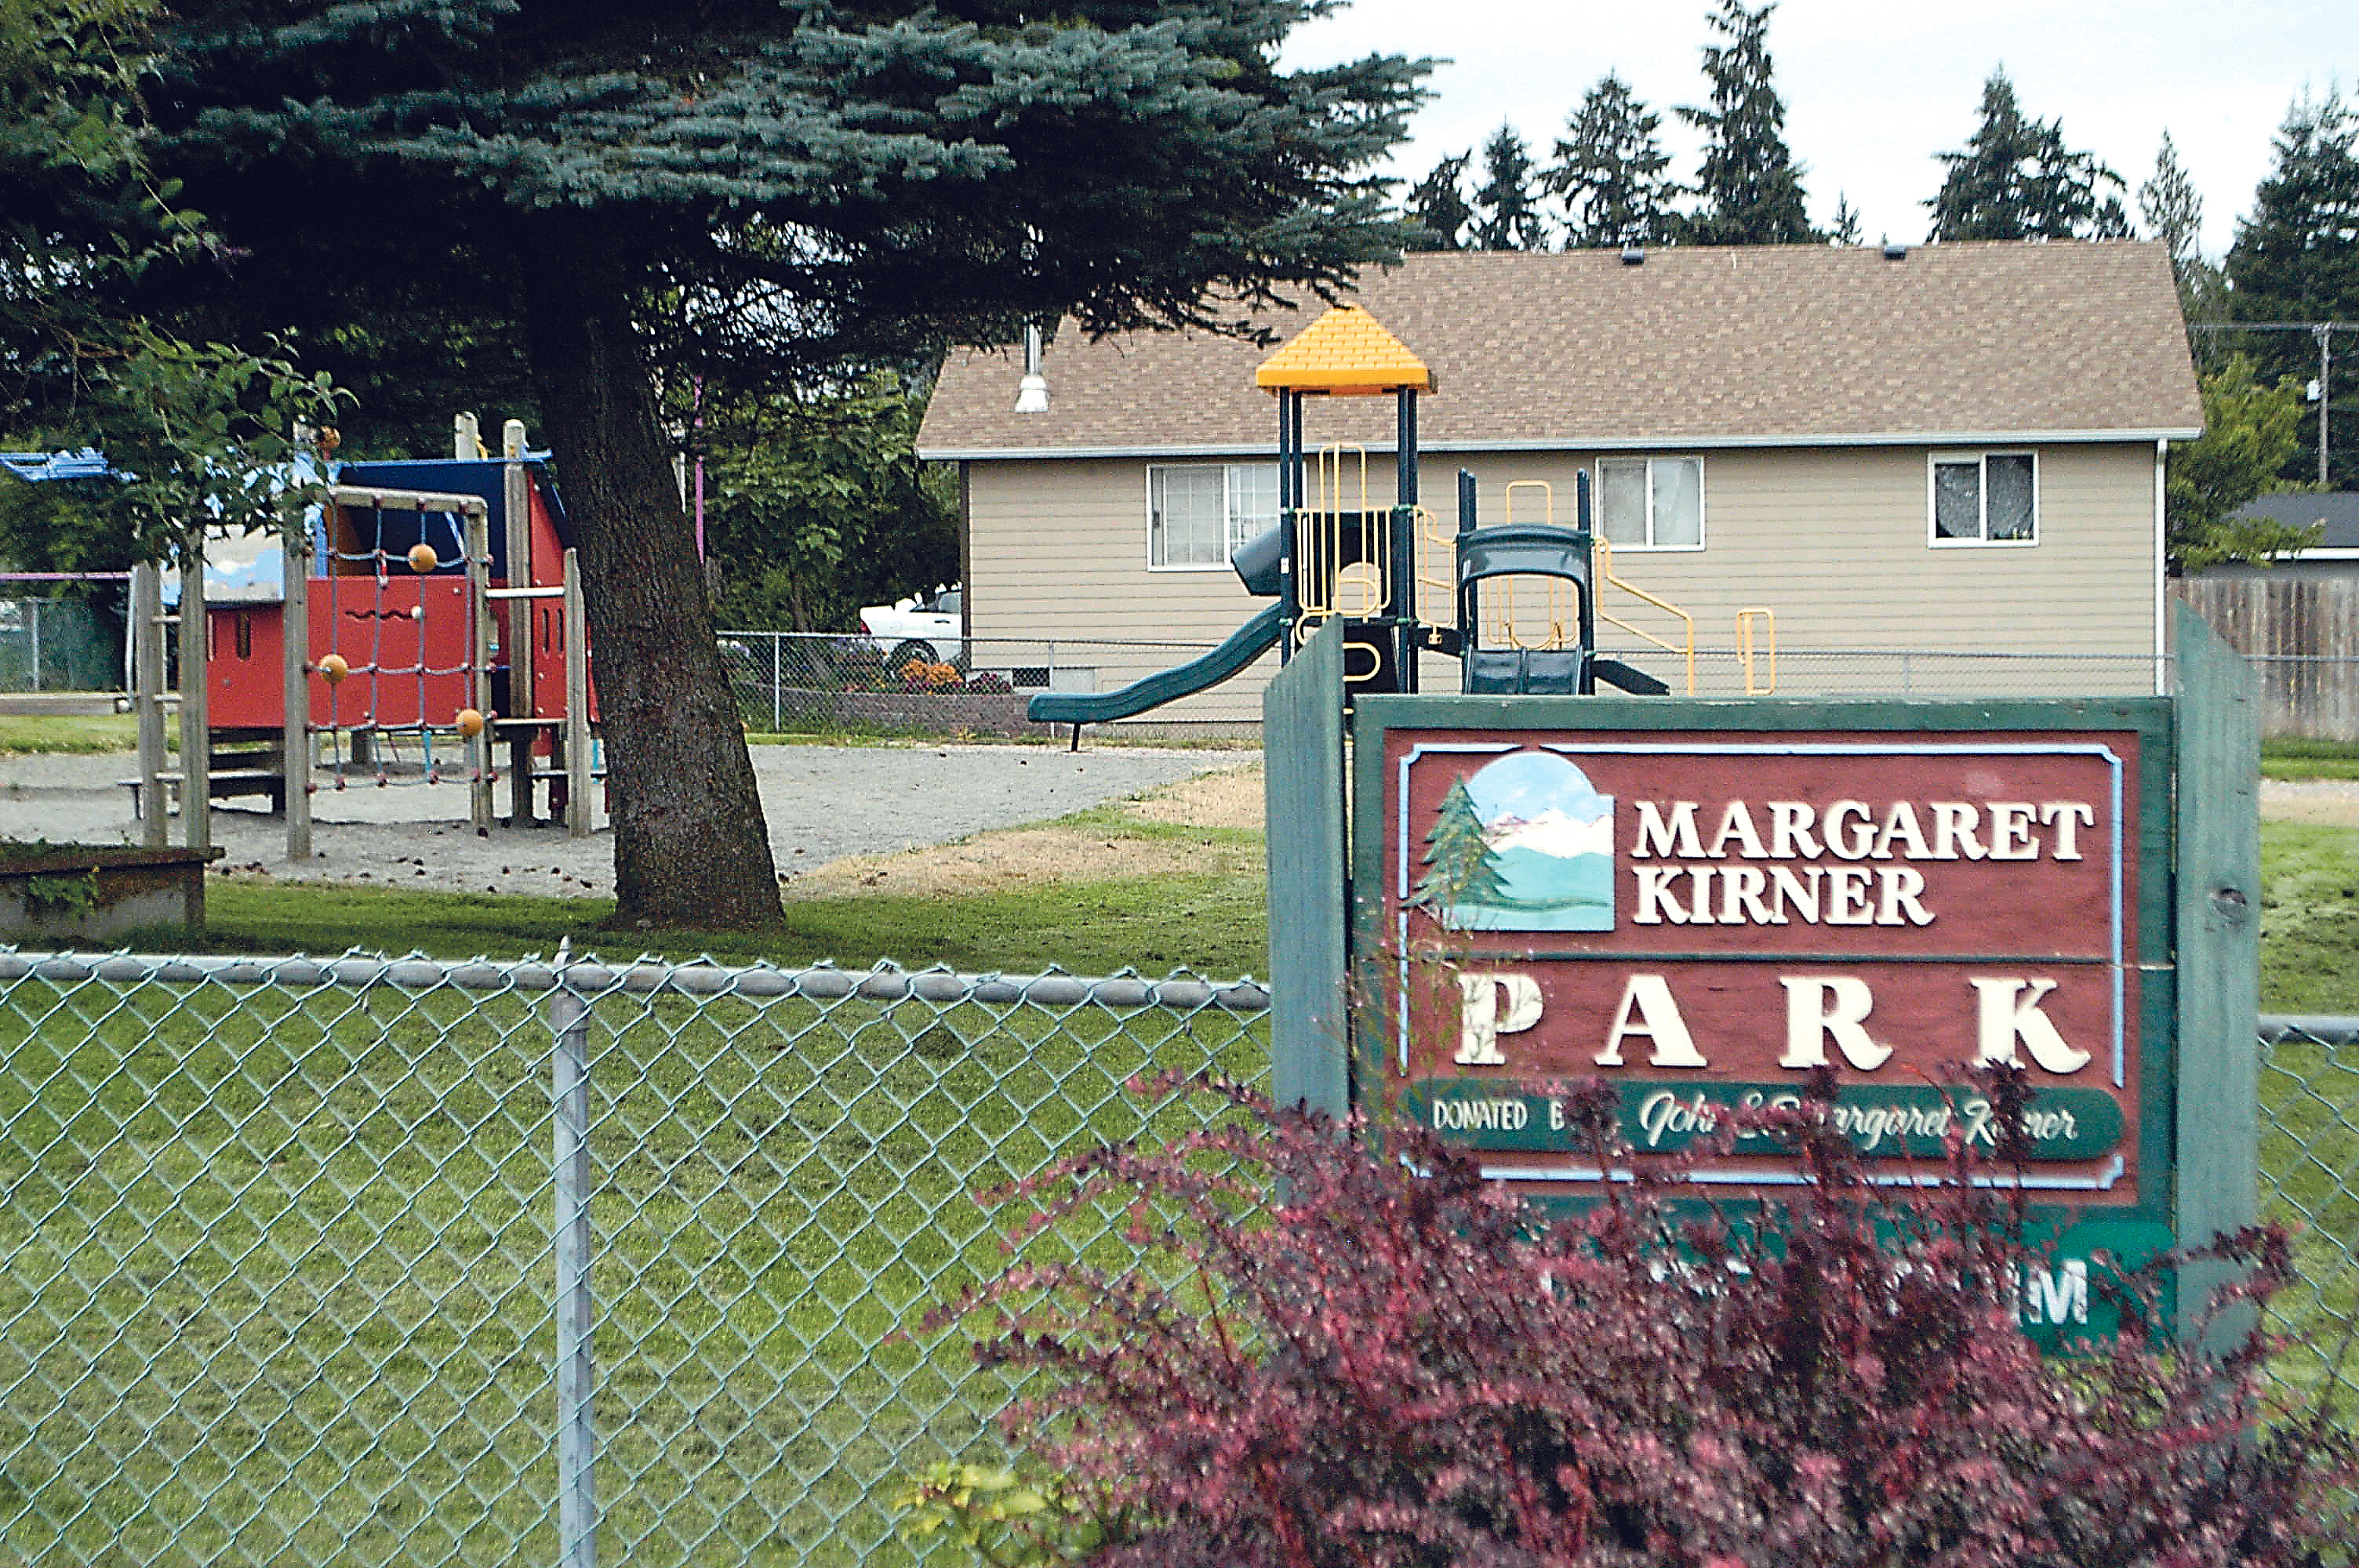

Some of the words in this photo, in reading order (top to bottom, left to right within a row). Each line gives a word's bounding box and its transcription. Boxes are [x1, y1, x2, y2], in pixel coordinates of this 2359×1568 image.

[1630, 799, 2095, 862] MARGARET
[1631, 866, 1937, 927] KIRNER
[1454, 973, 2092, 1075] PARK
[1432, 1099, 1529, 1131] DONATED
